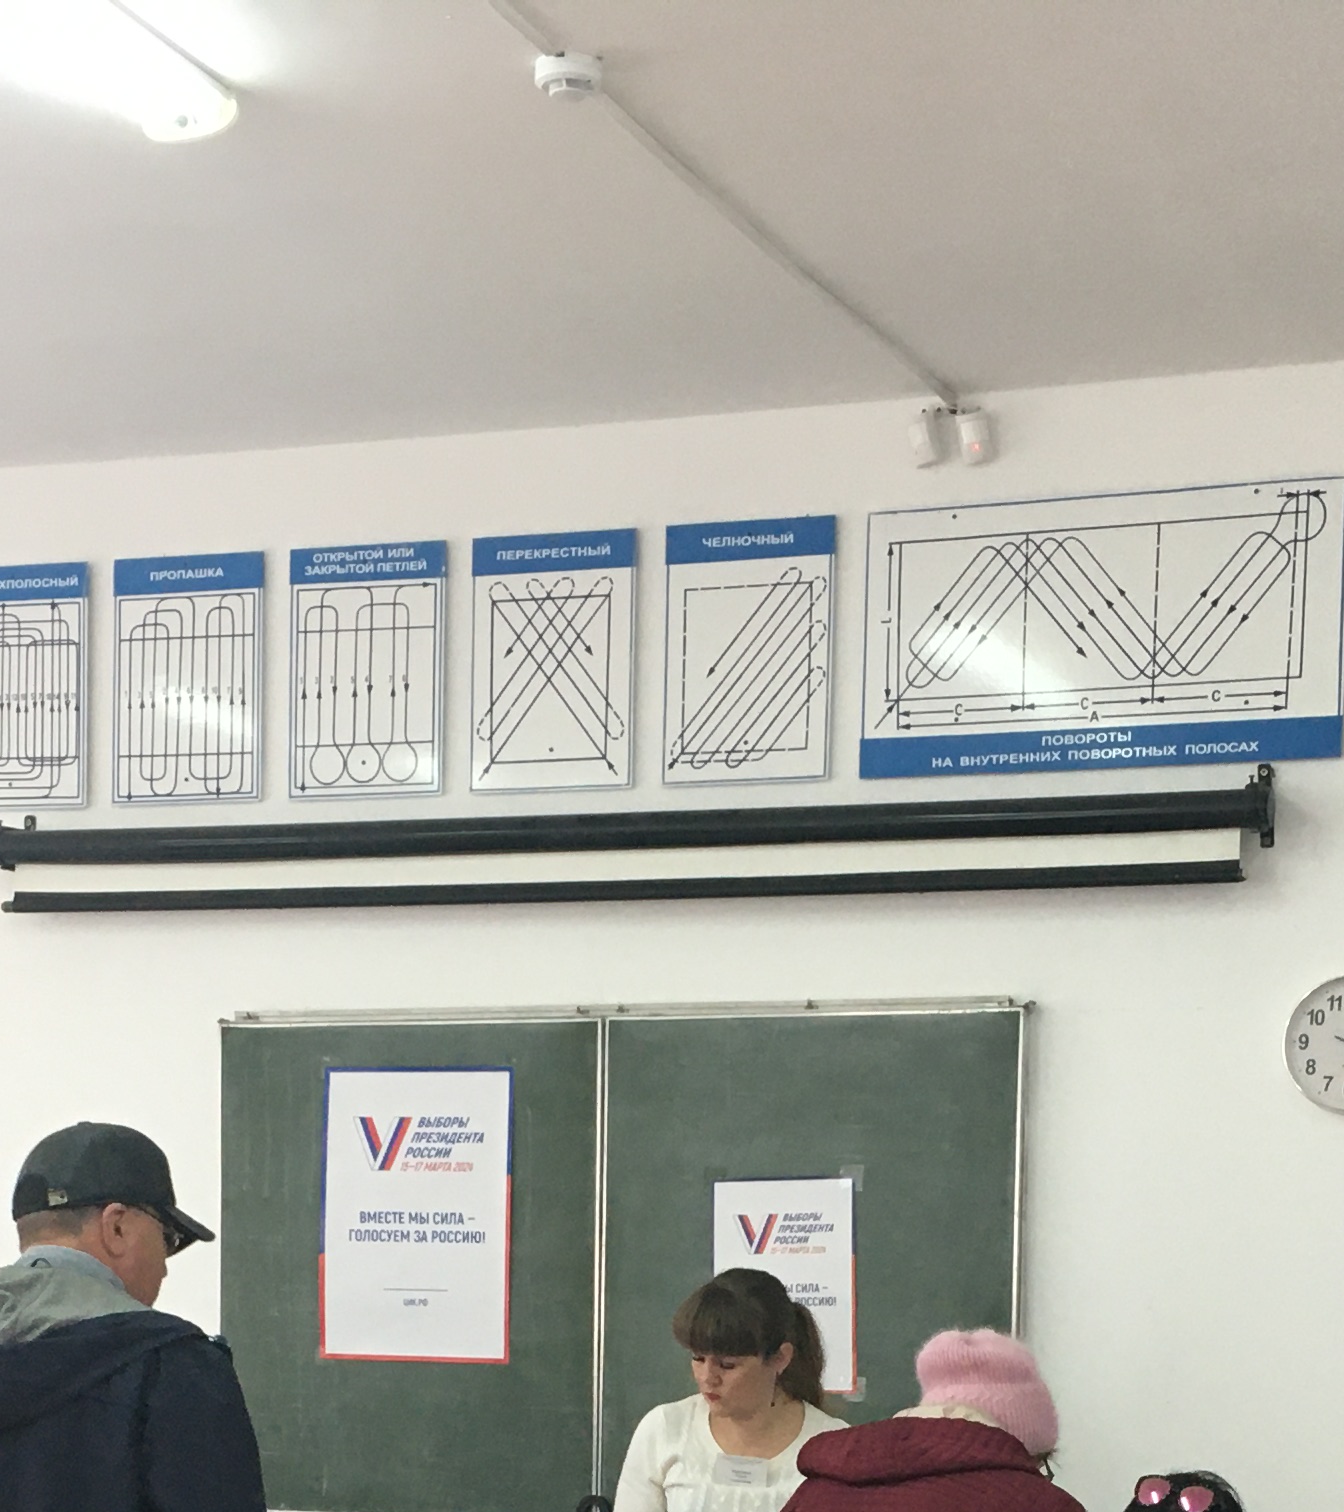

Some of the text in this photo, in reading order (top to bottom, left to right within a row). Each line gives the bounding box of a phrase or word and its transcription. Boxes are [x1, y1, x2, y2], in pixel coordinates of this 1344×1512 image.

[702, 531, 794, 549] ЧЕЛНОЧНЫЙ
[312, 547, 415, 564] ОТКРЫТОЙ ИЛИ
[496, 543, 611, 561] ПЕРЕКРЕСТНЫЙ
[150, 566, 224, 581] ПРОПАШКА
[304, 558, 427, 576] ЗАКРЫТОЙ ПЕТЛЕЙ
[1042, 731, 1132, 746] ПОВОРОТЫ
[932, 741, 1259, 768] НА ВНУТРЕННИХ ПОВОРОТНЫХ ПОЛОСАХ
[1326, 995, 1343, 1011] 11
[1307, 1009, 1325, 1026] 10
[1298, 1034, 1309, 1050] 9
[1306, 1059, 1316, 1075] 8
[1323, 1076, 1334, 1092] 7
[417, 1116, 470, 1129] ВЫБОРЫ
[410, 1131, 485, 1146] ПРЕЗИДЕНТА
[404, 1146, 453, 1159] РОССИИ
[359, 1210, 405, 1225] ВМЕСТЕ
[408, 1211, 429, 1225] МЫ
[432, 1211, 465, 1226] СИЛА
[348, 1228, 486, 1244] ГОЛОСУЕМ ЗА РОССИЮ!
[795, 1283, 820, 1293] СИЛА
